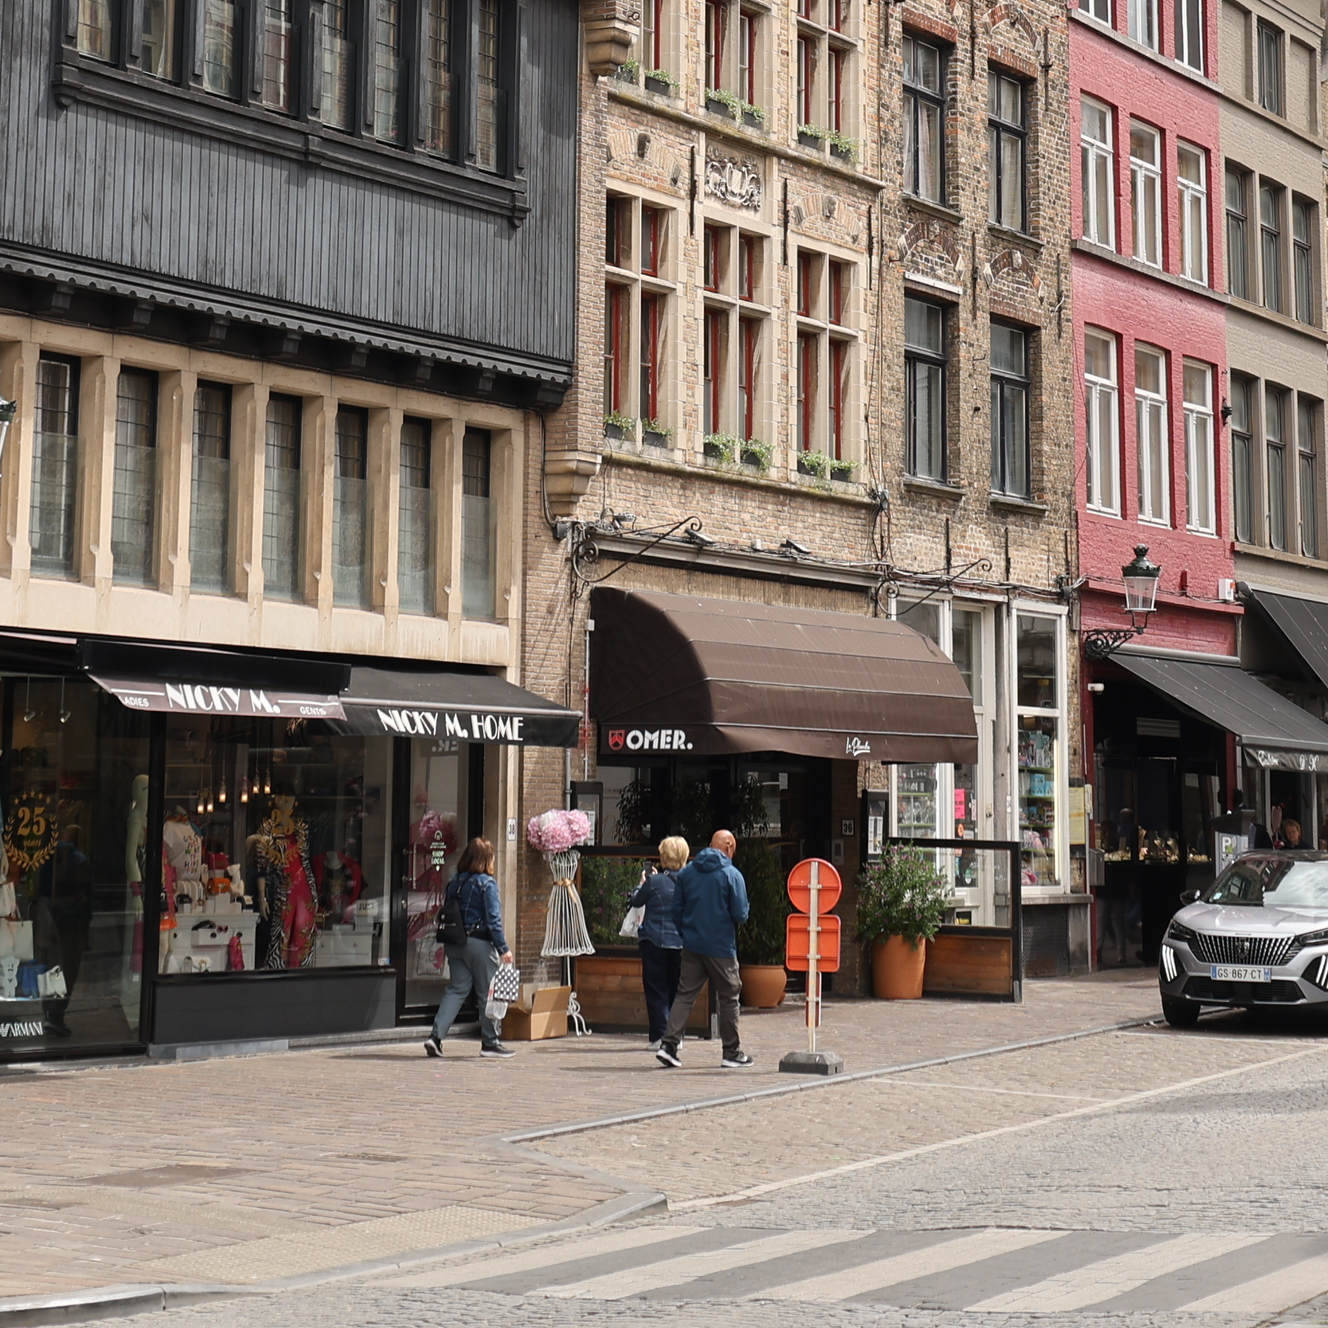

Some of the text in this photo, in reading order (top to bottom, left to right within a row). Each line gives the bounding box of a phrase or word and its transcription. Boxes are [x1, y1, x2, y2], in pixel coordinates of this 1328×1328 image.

[119, 695, 150, 708] LADIES
[164, 682, 281, 715] NICKY M.
[376, 708, 525, 741] NICKY M. HOME
[626, 730, 693, 750] OMER.
[17, 806, 47, 836] 25
[1217, 967, 1263, 980] GS 867 CT
[10, 1022, 44, 1037] ARMANI
